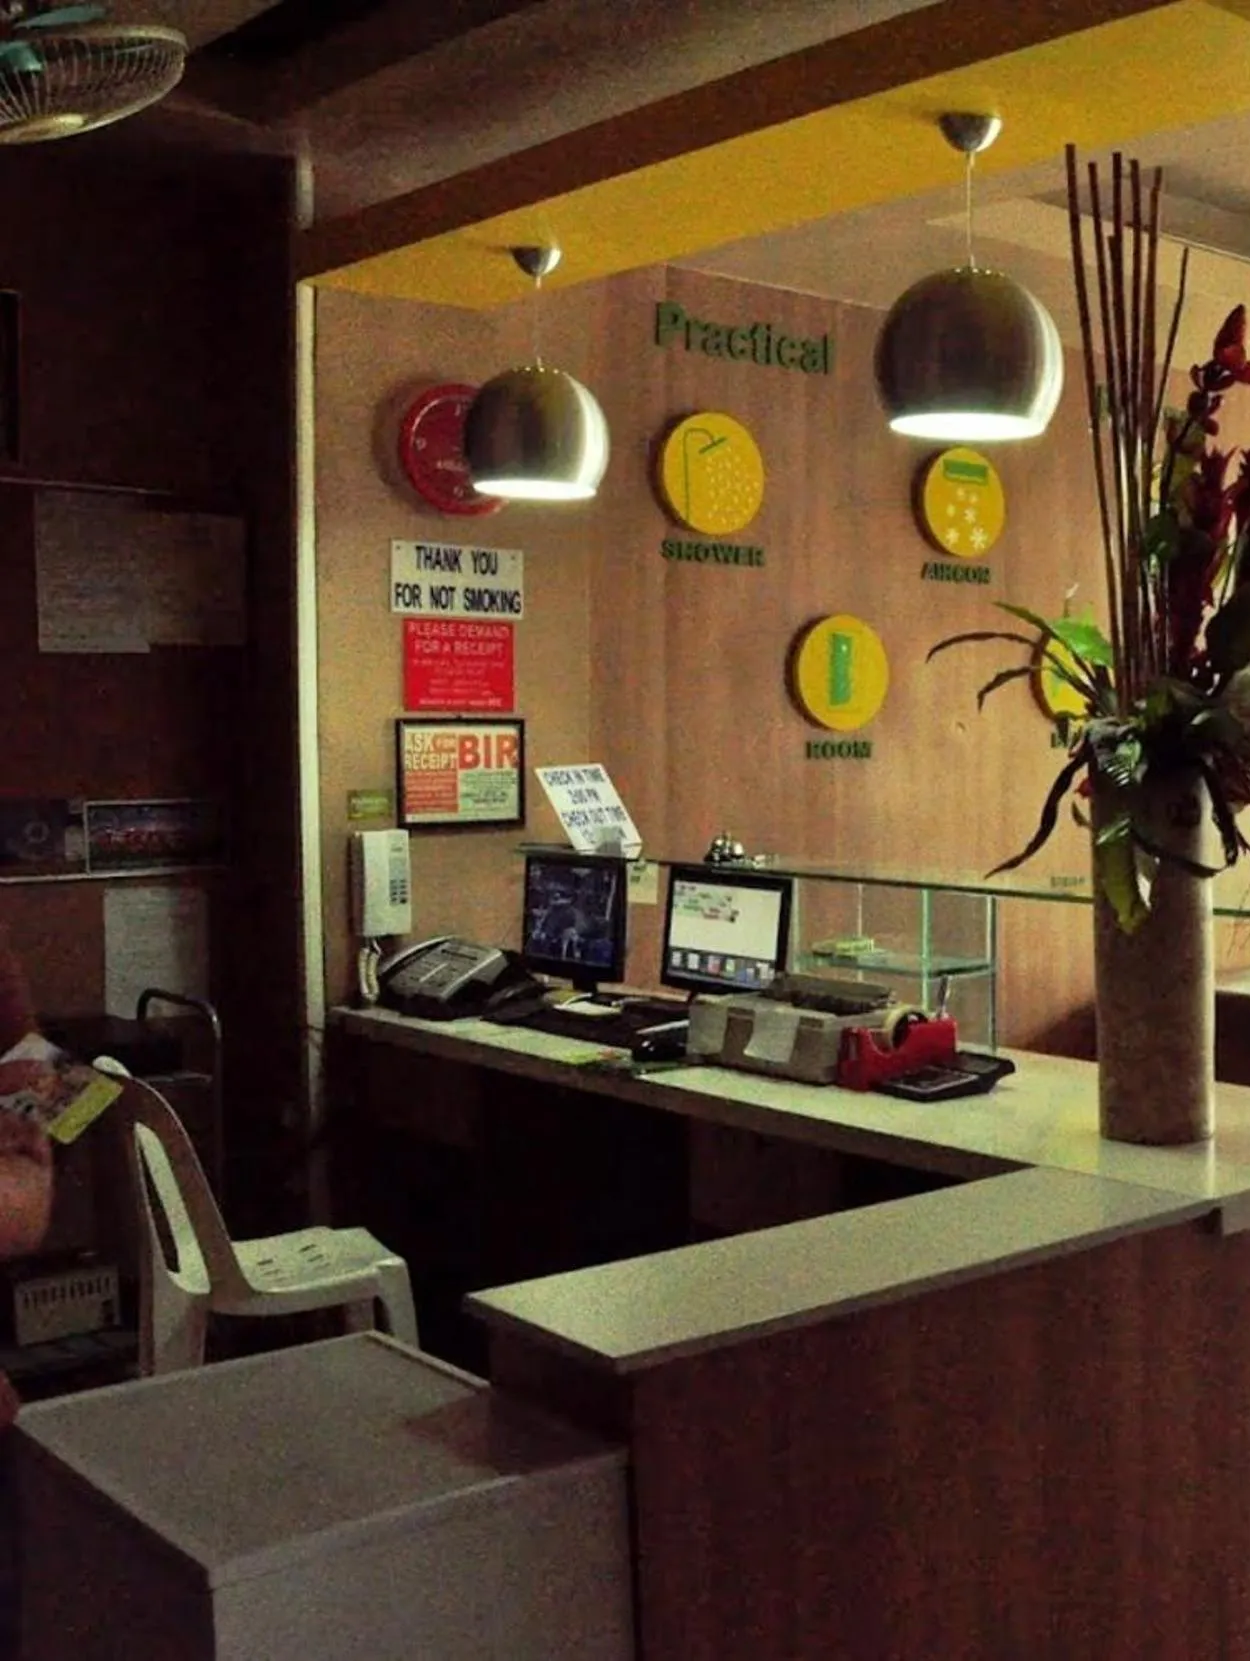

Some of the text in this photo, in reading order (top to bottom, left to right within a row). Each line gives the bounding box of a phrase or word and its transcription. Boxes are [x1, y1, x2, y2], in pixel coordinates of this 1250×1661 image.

[655, 301, 834, 375] Practical
[415, 545, 498, 576] THANK YOU
[660, 539, 766, 568] SHOWER
[395, 582, 521, 613] FOR NOT SMOKING
[408, 621, 510, 639] PLEASE DEMAND
[414, 639, 504, 657] FOR A RECEIPT
[405, 733, 432, 753] ASK
[459, 734, 518, 769] BIR
[405, 753, 457, 770] RECEIPT
[805, 740, 873, 760] ROOM
